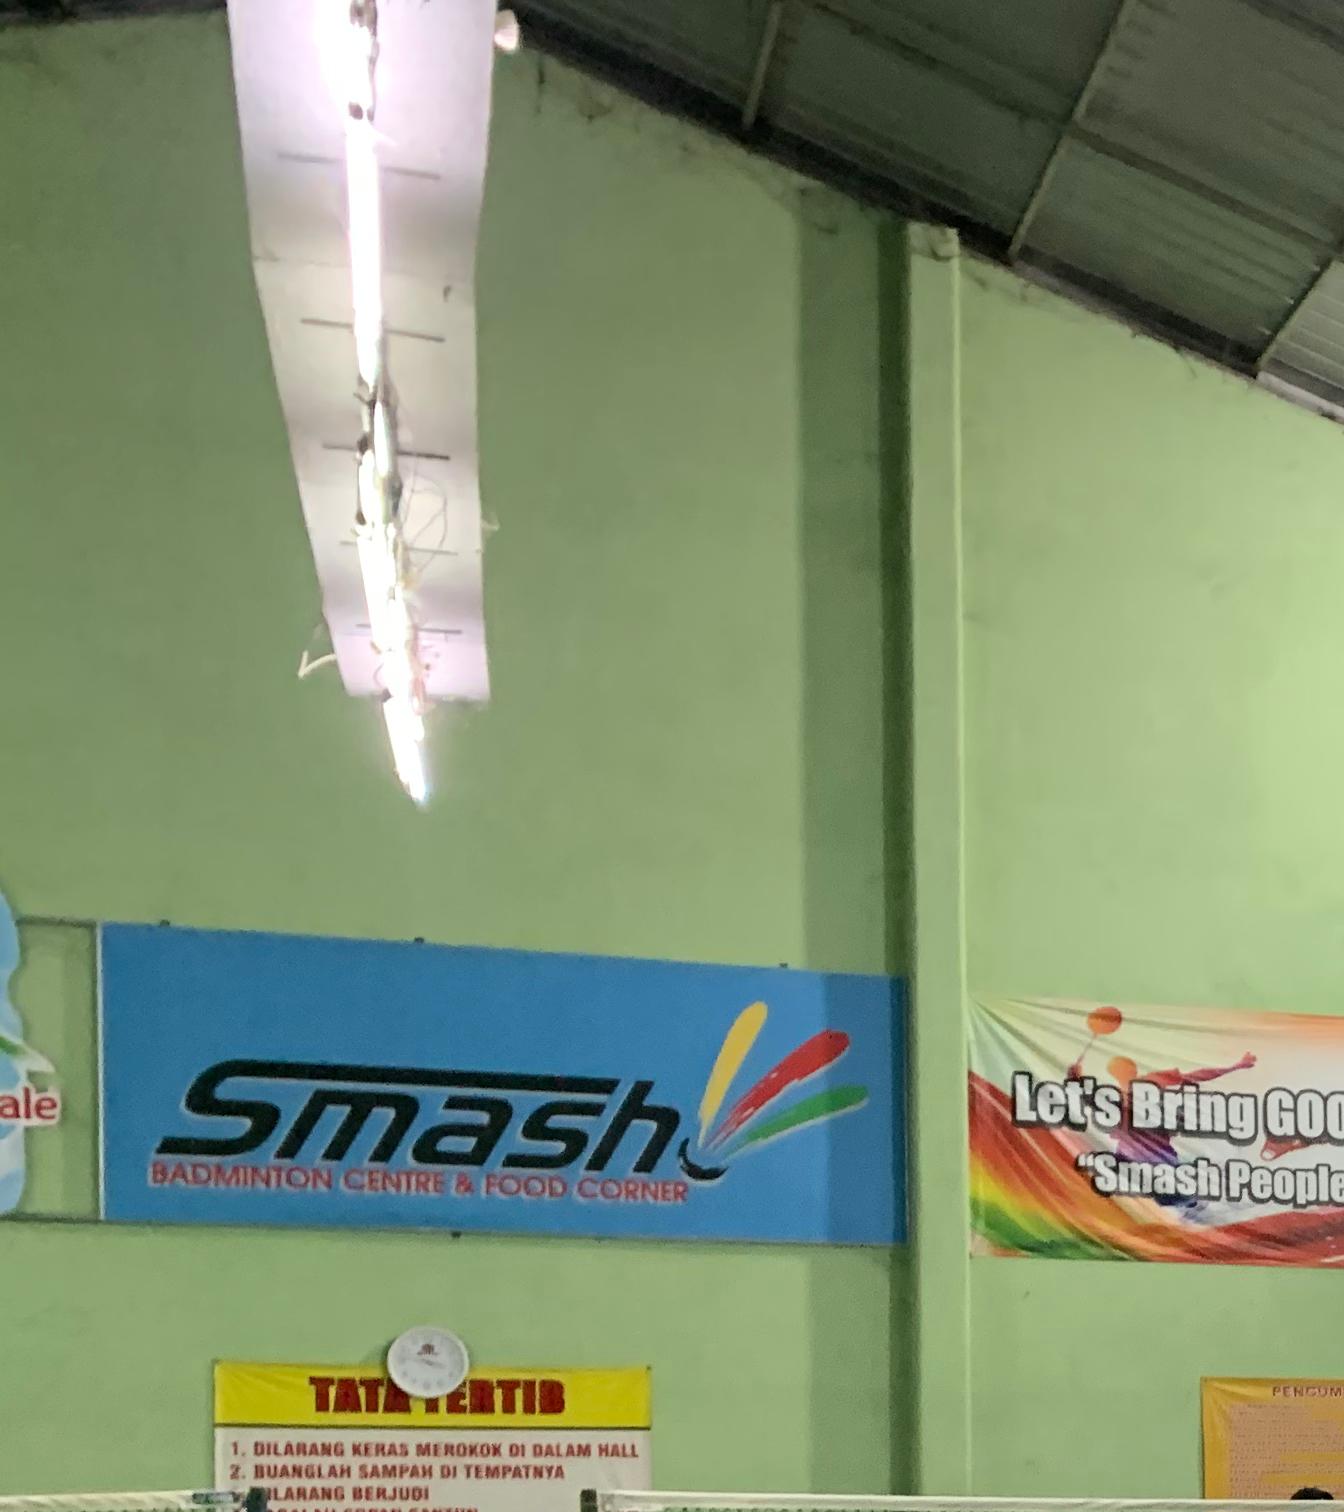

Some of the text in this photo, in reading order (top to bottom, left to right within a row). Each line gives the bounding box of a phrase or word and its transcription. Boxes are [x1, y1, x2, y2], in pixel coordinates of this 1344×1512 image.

[155, 1057, 680, 1175] Smash
[1012, 1070, 1123, 1131] Let's
[1130, 1079, 1258, 1146] Bring
[150, 1161, 689, 1203] BADMINTON CENTRE & FOOD CORNER
[308, 1376, 412, 1414] TATA
[231, 1441, 640, 1459] 1. DILARANG KERAS MEROKOK DI DALAM HALL
[230, 1464, 566, 1480] 2. BUANGLAH SAMPAH DI TEMPATNYA
[266, 1486, 345, 1502] ILARANG
[351, 1486, 430, 1502] BERJUDI
